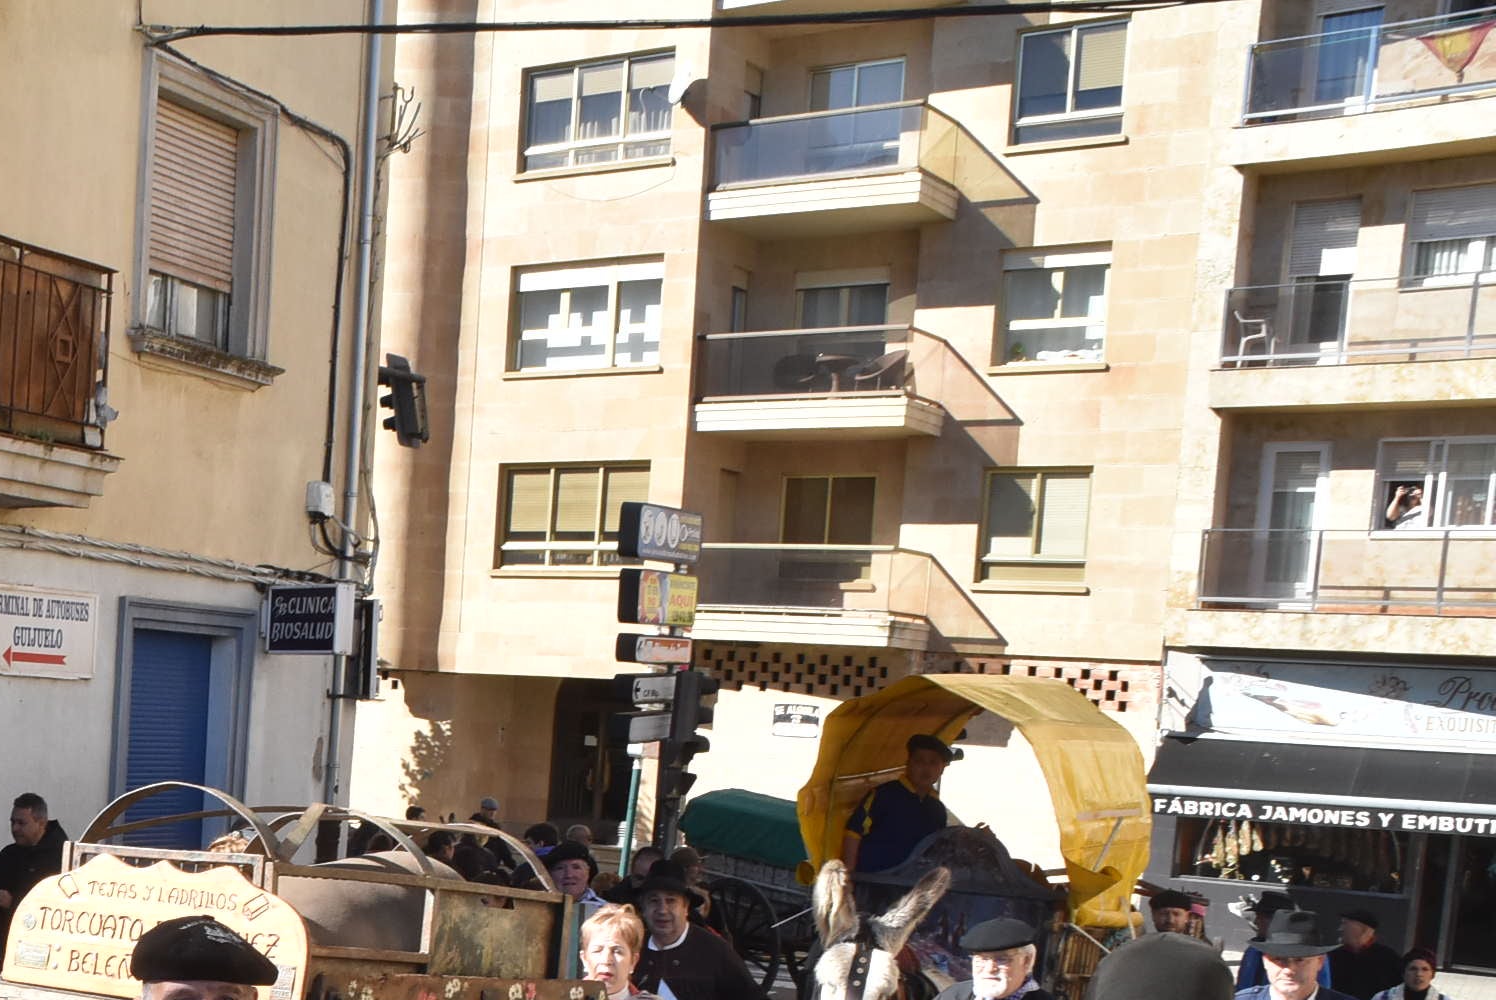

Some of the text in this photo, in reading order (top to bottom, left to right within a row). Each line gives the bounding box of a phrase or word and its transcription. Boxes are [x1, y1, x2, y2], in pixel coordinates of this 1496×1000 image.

[32, 596, 43, 618] DE
[45, 597, 89, 622] AUTOBUSES
[12, 626, 63, 649] GUIJUELO
[271, 621, 334, 642] BIOSALUD
[1154, 796, 1252, 819] FÁBRICA
[1259, 804, 1370, 827] JAMONES
[1377, 811, 1395, 828] Y
[87, 880, 137, 900] TEJAS
[142, 884, 155, 901] Y
[38, 906, 144, 942] TORCUATO
